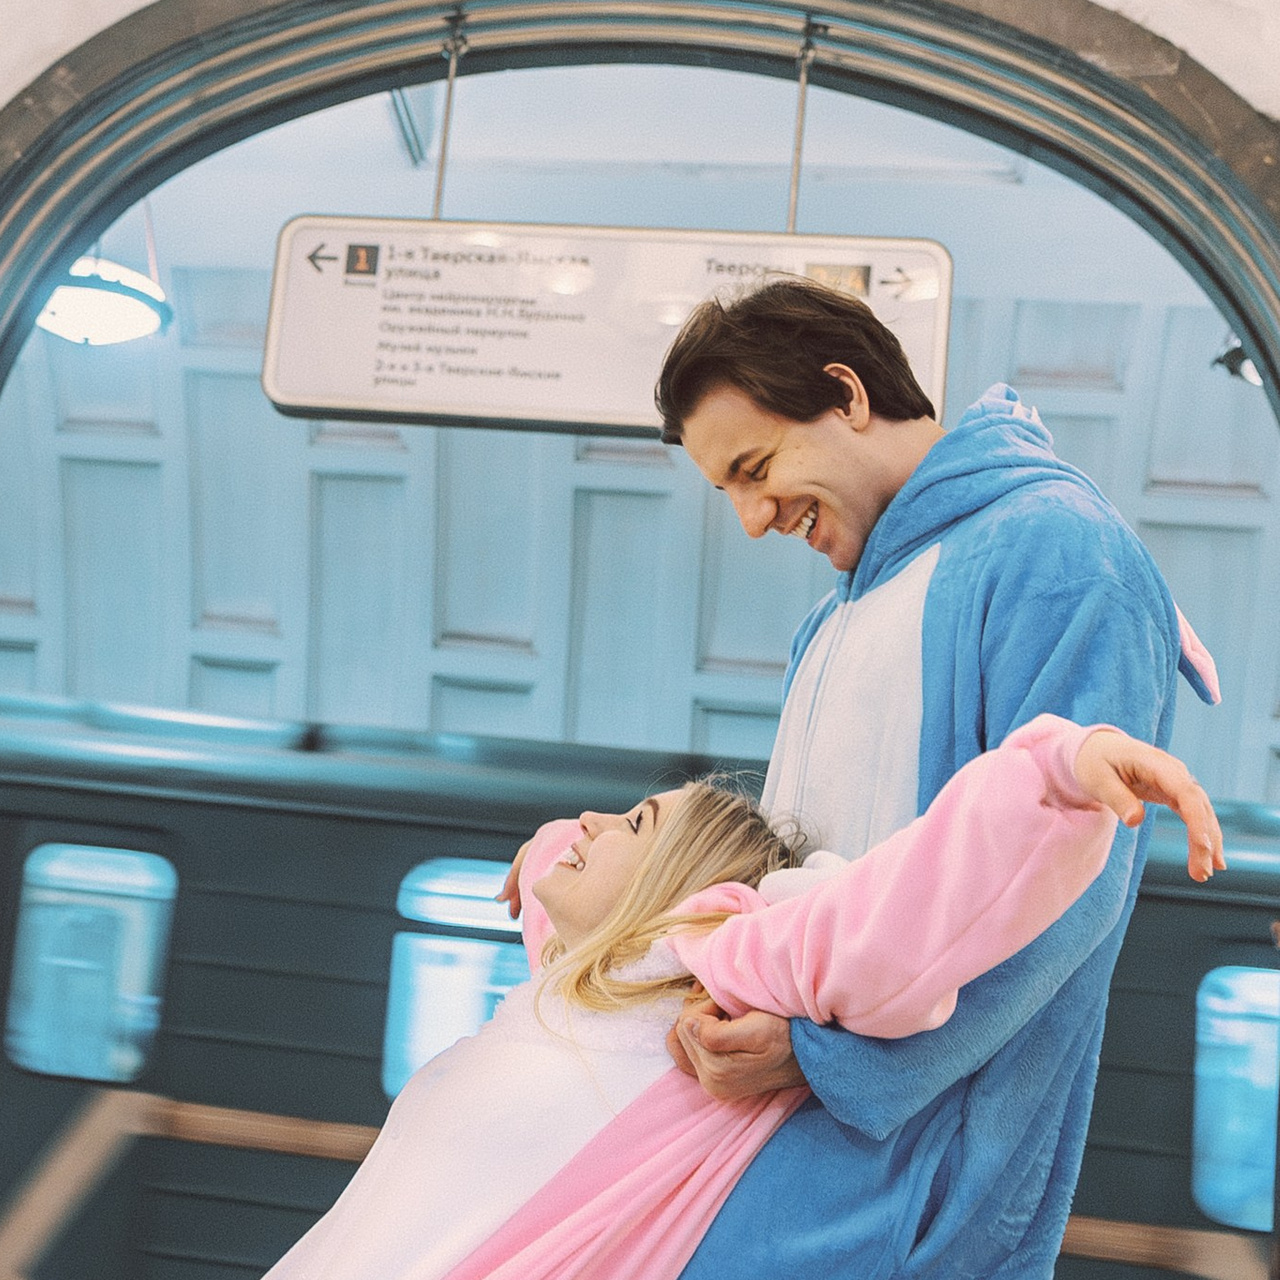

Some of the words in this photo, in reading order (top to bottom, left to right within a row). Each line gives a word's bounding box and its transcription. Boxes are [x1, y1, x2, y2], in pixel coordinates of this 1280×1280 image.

[353, 246, 369, 272] 1
[387, 244, 414, 262] 1-я
[384, 267, 441, 283] улица
